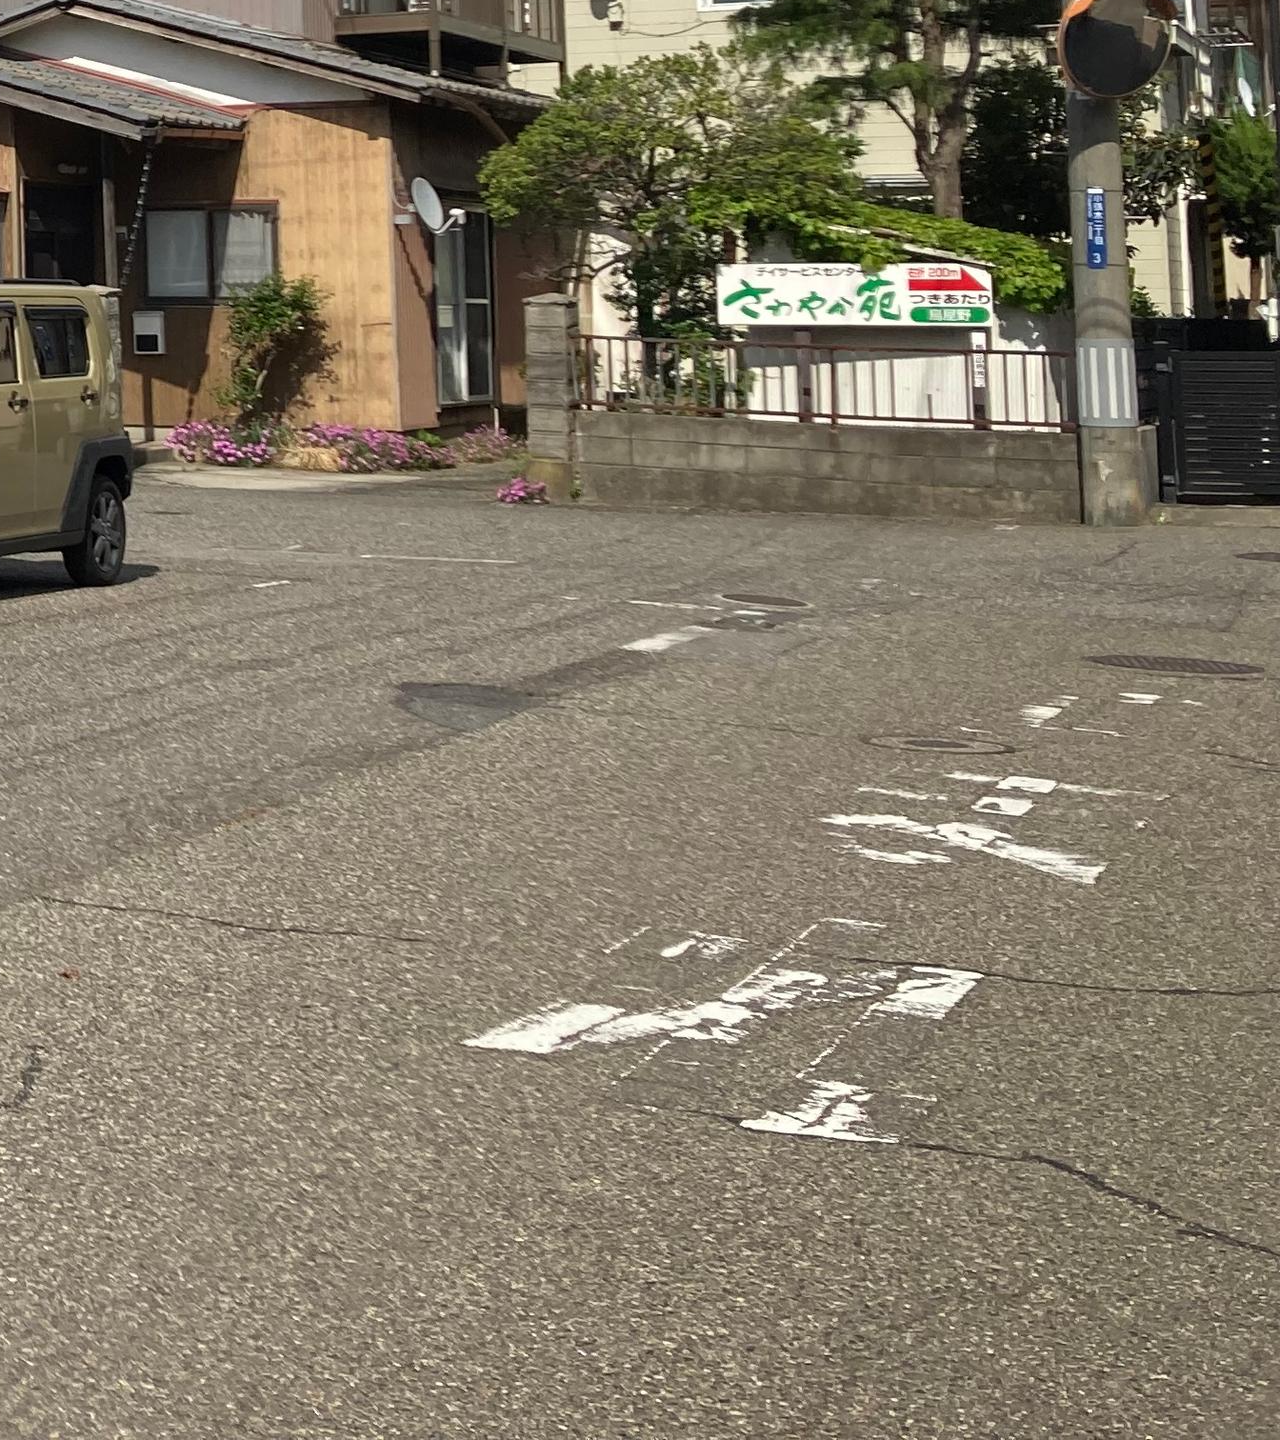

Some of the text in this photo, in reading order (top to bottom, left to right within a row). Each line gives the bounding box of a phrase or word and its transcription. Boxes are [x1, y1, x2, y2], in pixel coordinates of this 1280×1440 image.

[1092, 252, 1102, 264] 3
[928, 267, 959, 278] 200m
[723, 273, 902, 322] さわやか苑
[908, 293, 991, 305] つきあたり
